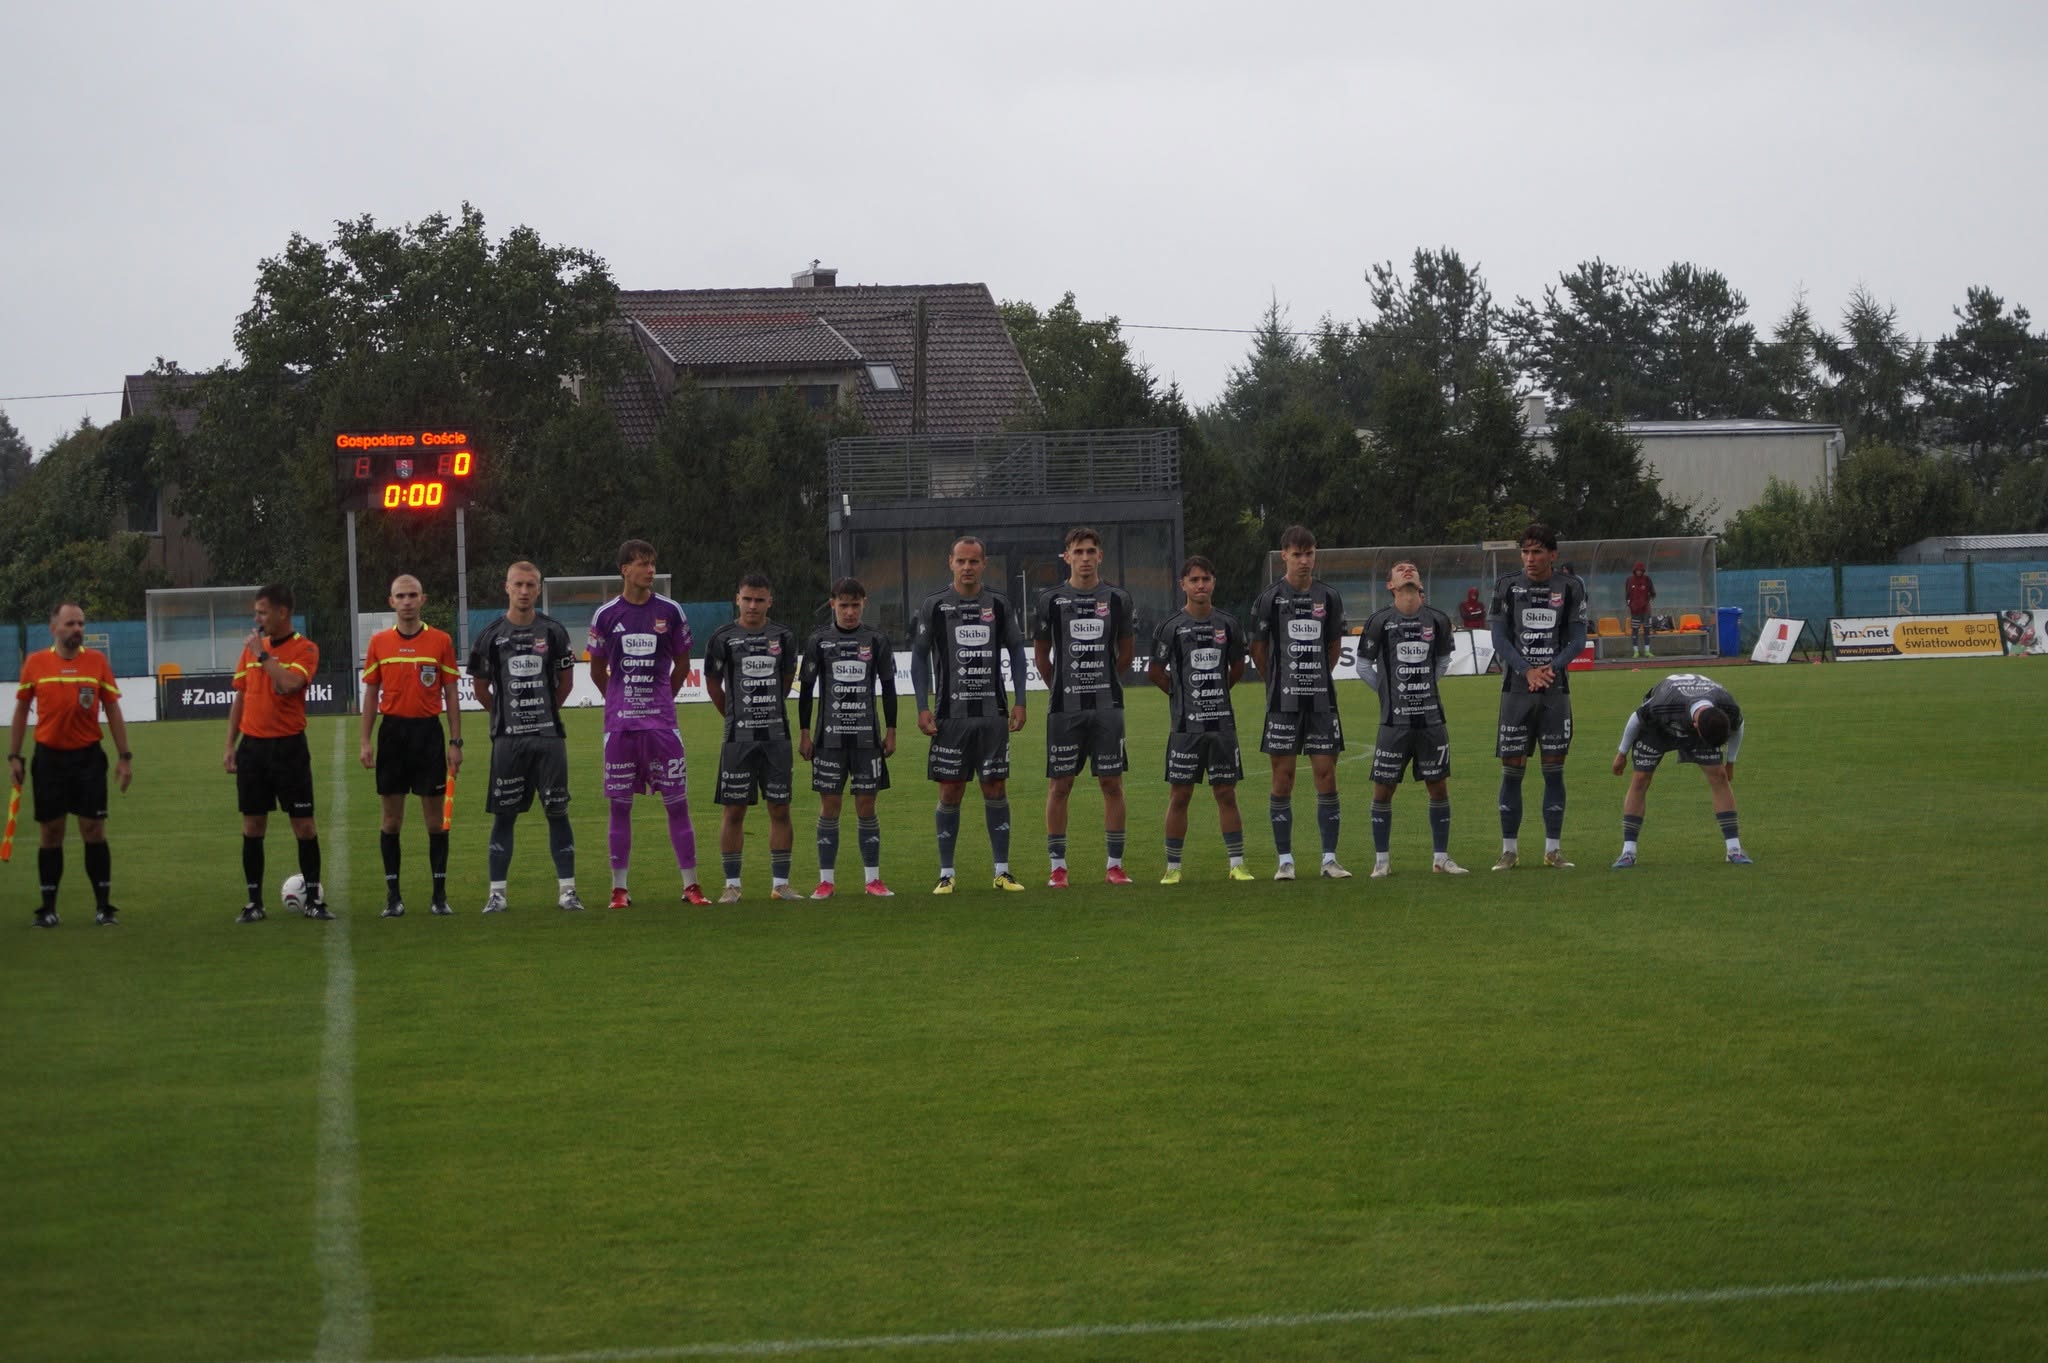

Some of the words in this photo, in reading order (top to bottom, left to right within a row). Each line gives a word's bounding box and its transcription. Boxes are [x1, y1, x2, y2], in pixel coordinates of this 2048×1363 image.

[337, 434, 415, 449] Gospodarze
[422, 432, 467, 445] Goście
[454, 453, 470, 475] 0
[384, 483, 442, 507] 0:00
[1525, 612, 1553, 621] Skiba
[1073, 623, 1101, 632] Skiba
[1292, 624, 1318, 633] Skiba
[1903, 625, 1949, 635] Internet
[959, 629, 987, 638] Skiba
[1835, 626, 1890, 641] Lynxnet
[625, 639, 653, 648] Skiba
[1905, 635, 1997, 649] światłowodowy
[959, 650, 992, 658] GINTER
[1400, 646, 1426, 655] Skiba
[1839, 646, 1894, 655] www.lynxnet.pl
[1194, 653, 1218, 662] Skiba
[512, 660, 538, 669] Skiba
[745, 660, 772, 669] Skiba
[1080, 661, 1104, 669] EMKA
[835, 665, 863, 674] Skiba
[968, 667, 992, 675] EMKA
[511, 680, 543, 689] GINTER
[834, 685, 867, 693] GINTER
[1407, 682, 1430, 691] EMKA
[1201, 688, 1224, 697] EMKA
[520, 697, 544, 706] EMKA
[752, 695, 776, 703] EMKA
[841, 702, 866, 710] EMKA
[668, 757, 686, 778] 22
